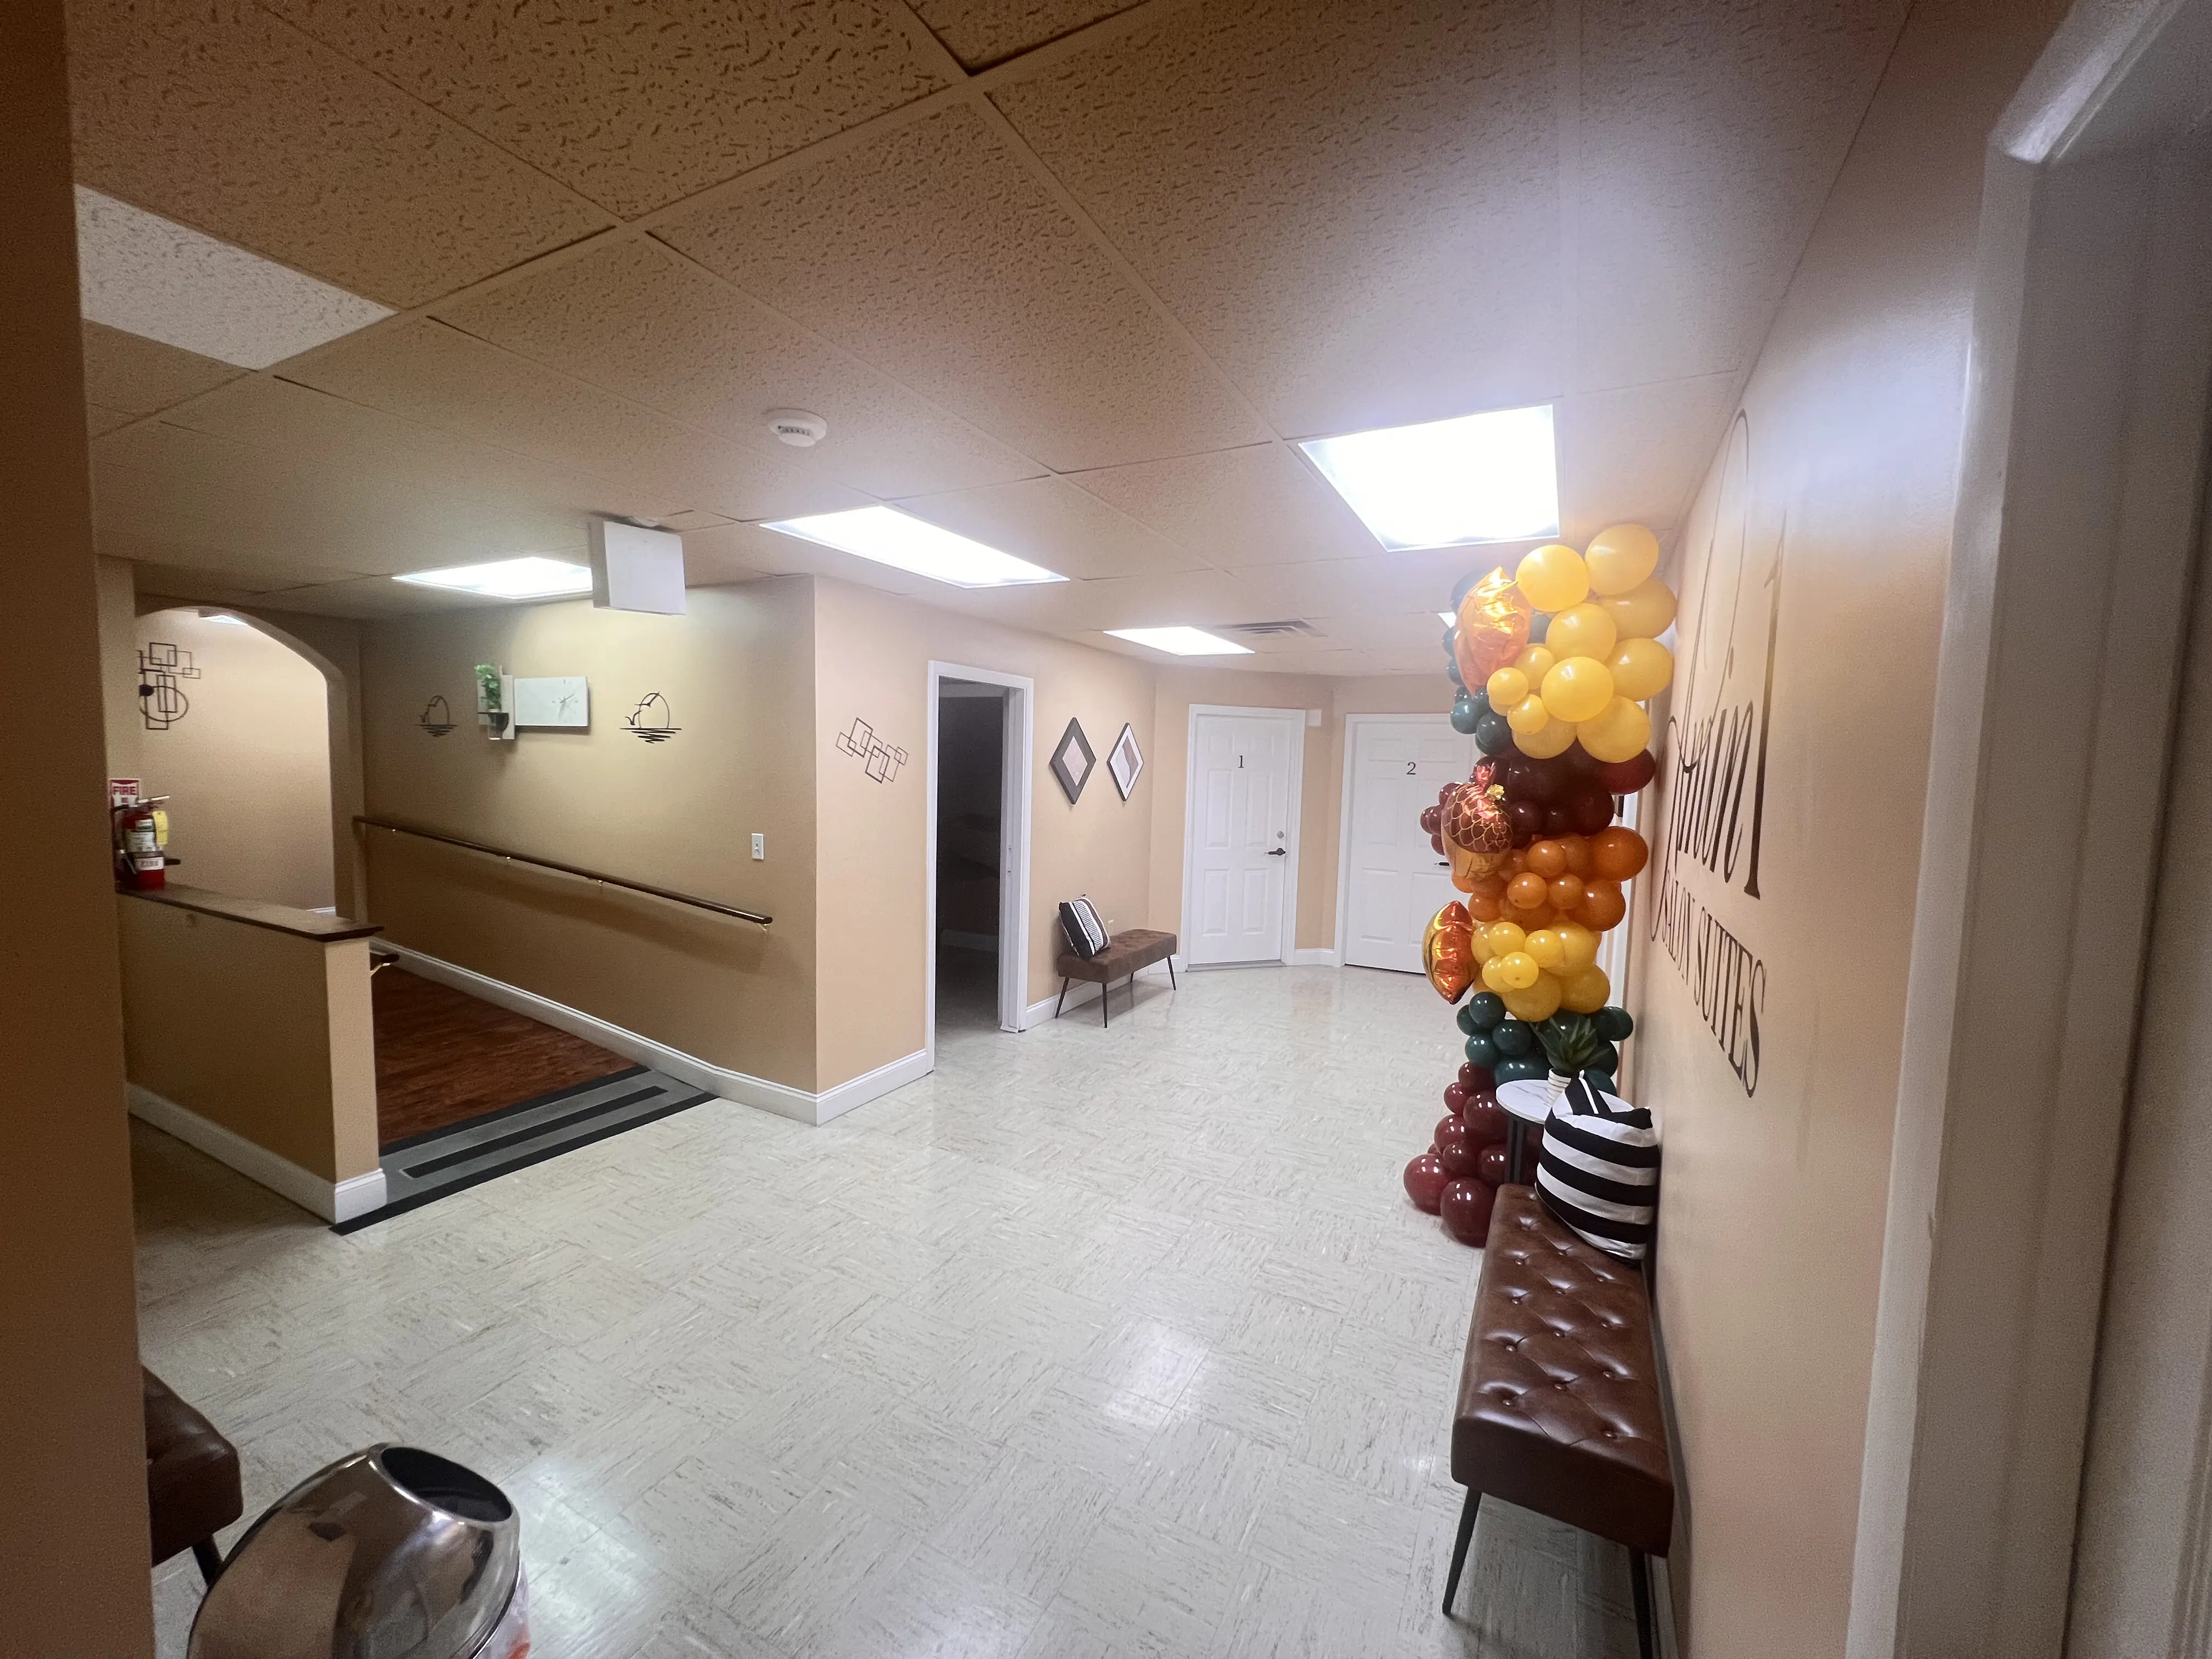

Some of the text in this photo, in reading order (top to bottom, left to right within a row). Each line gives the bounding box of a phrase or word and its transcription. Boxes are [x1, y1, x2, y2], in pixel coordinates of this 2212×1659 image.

[1743, 509, 1787, 901] 1
[1237, 754, 1245, 769] 1
[1406, 761, 1417, 775] 2
[113, 786, 137, 795] FIRE
[1662, 868, 1767, 1099] SALON SUITES
